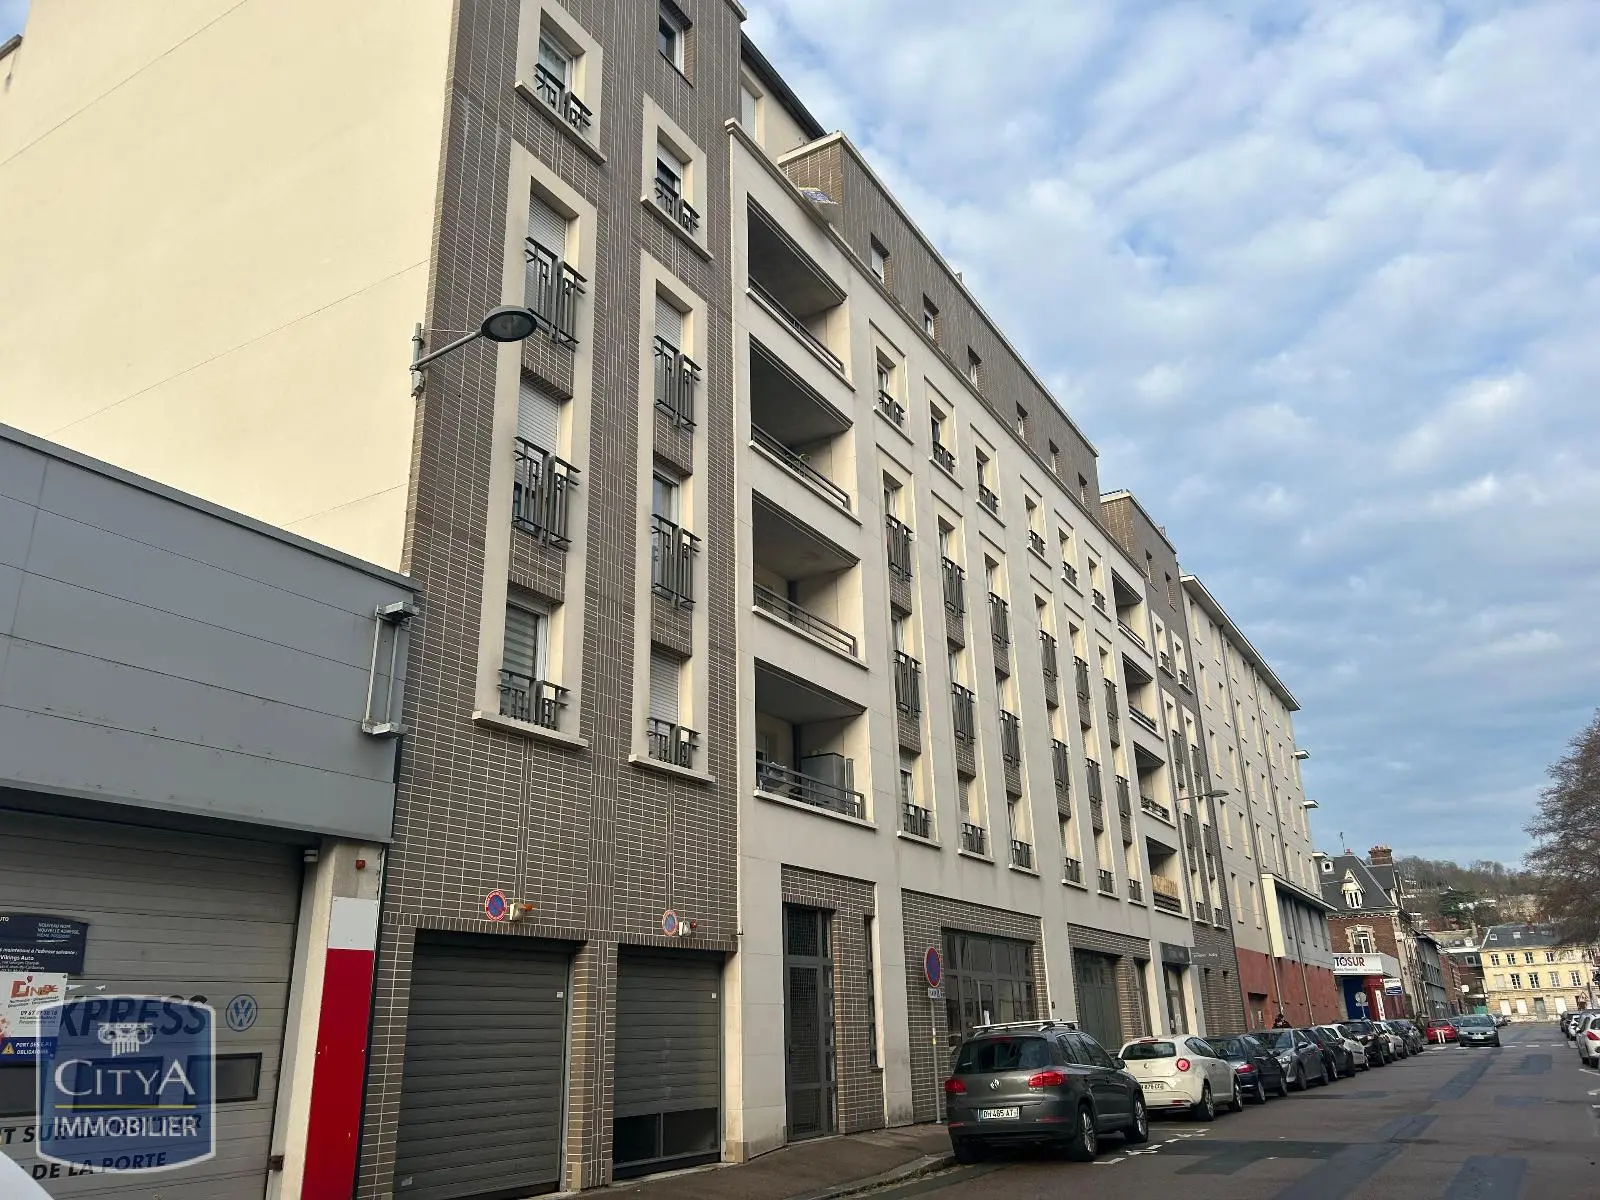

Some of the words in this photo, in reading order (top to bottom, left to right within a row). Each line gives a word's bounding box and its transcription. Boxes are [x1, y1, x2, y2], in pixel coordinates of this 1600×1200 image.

[1334, 956, 1366, 967] TOSUR
[60, 995, 208, 1037] XPRESS
[32, 1163, 61, 1180] DE
[101, 1151, 167, 1173] PORTE
